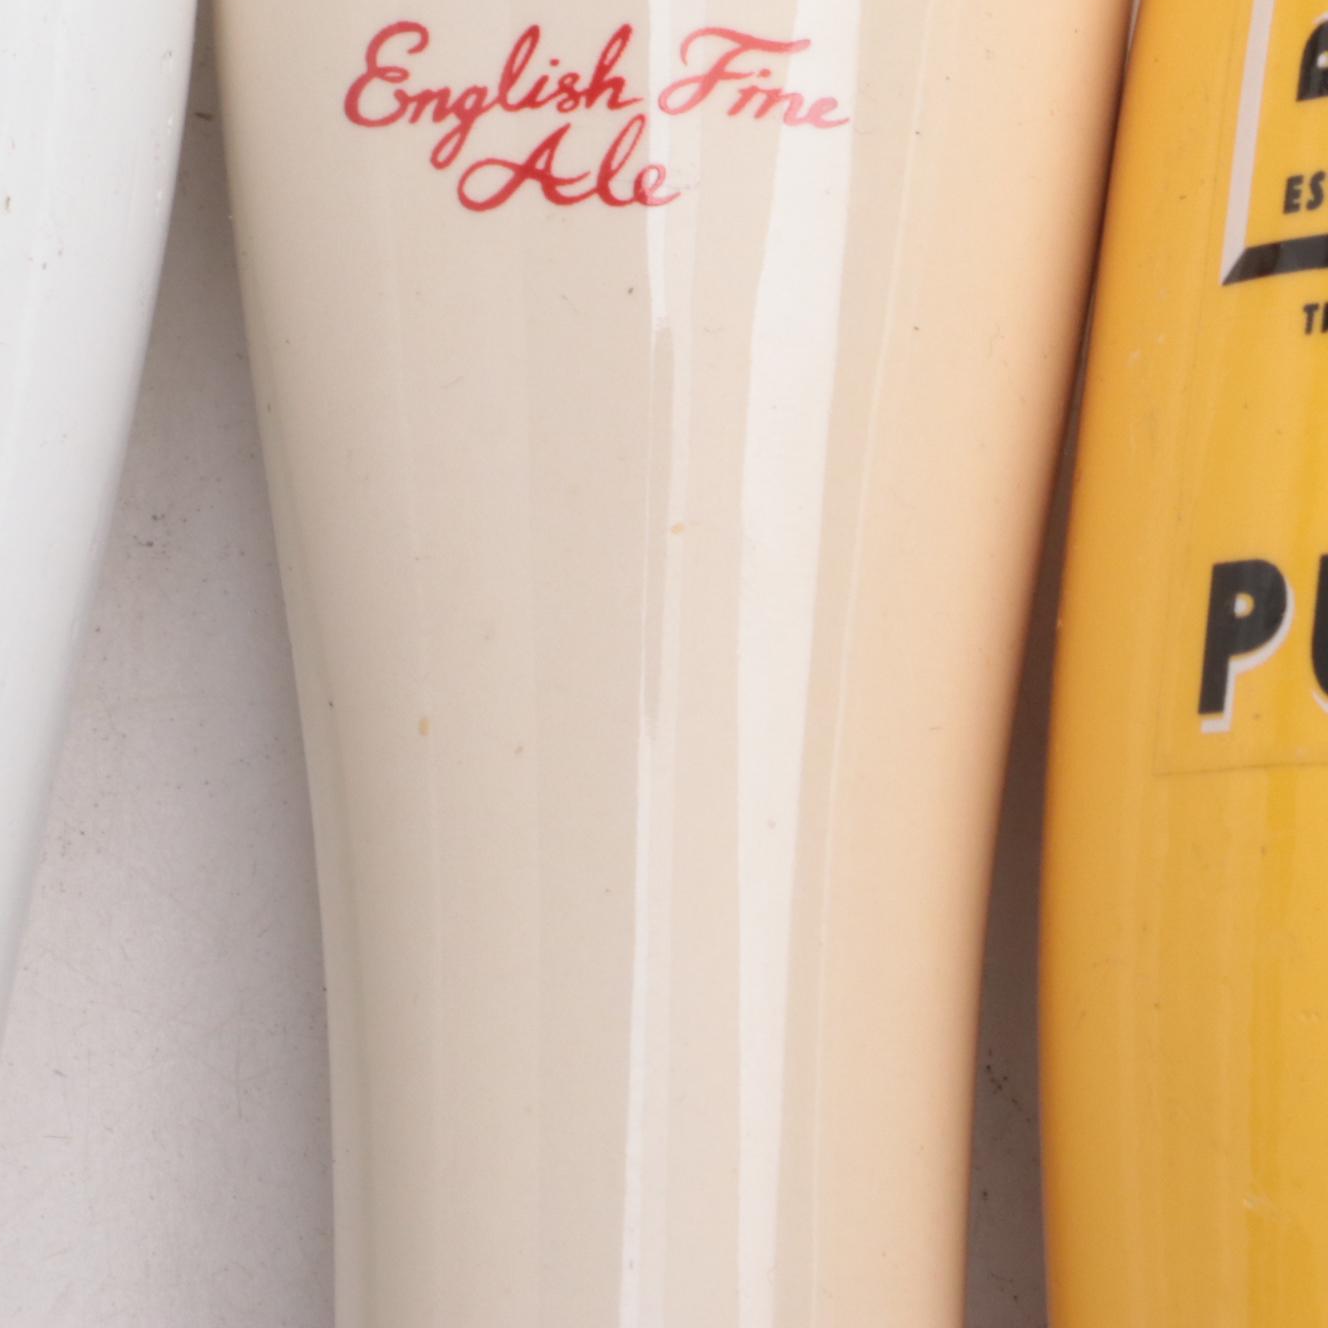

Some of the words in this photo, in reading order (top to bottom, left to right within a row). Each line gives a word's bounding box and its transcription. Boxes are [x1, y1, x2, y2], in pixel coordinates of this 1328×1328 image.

[343, 20, 641, 170] English
[658, 26, 851, 131] Fine
[457, 114, 682, 213] Ale
